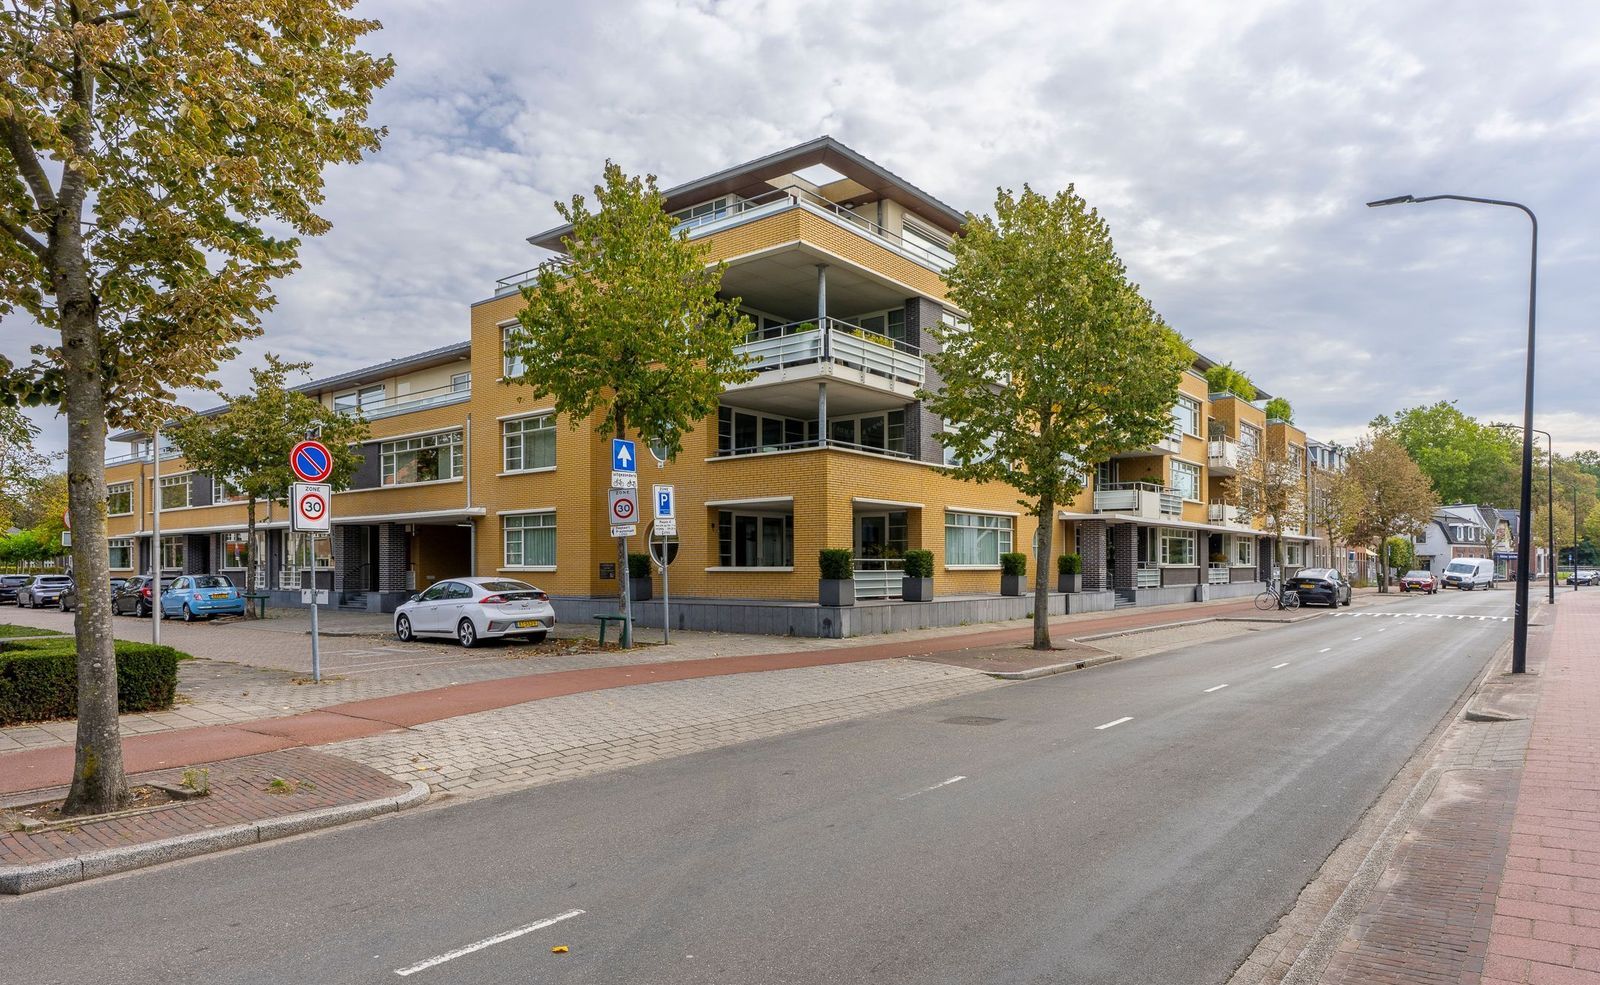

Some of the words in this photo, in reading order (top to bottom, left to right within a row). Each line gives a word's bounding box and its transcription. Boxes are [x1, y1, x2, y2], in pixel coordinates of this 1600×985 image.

[660, 493, 668, 506] P
[305, 501, 322, 512] 30
[617, 504, 630, 513] 30
